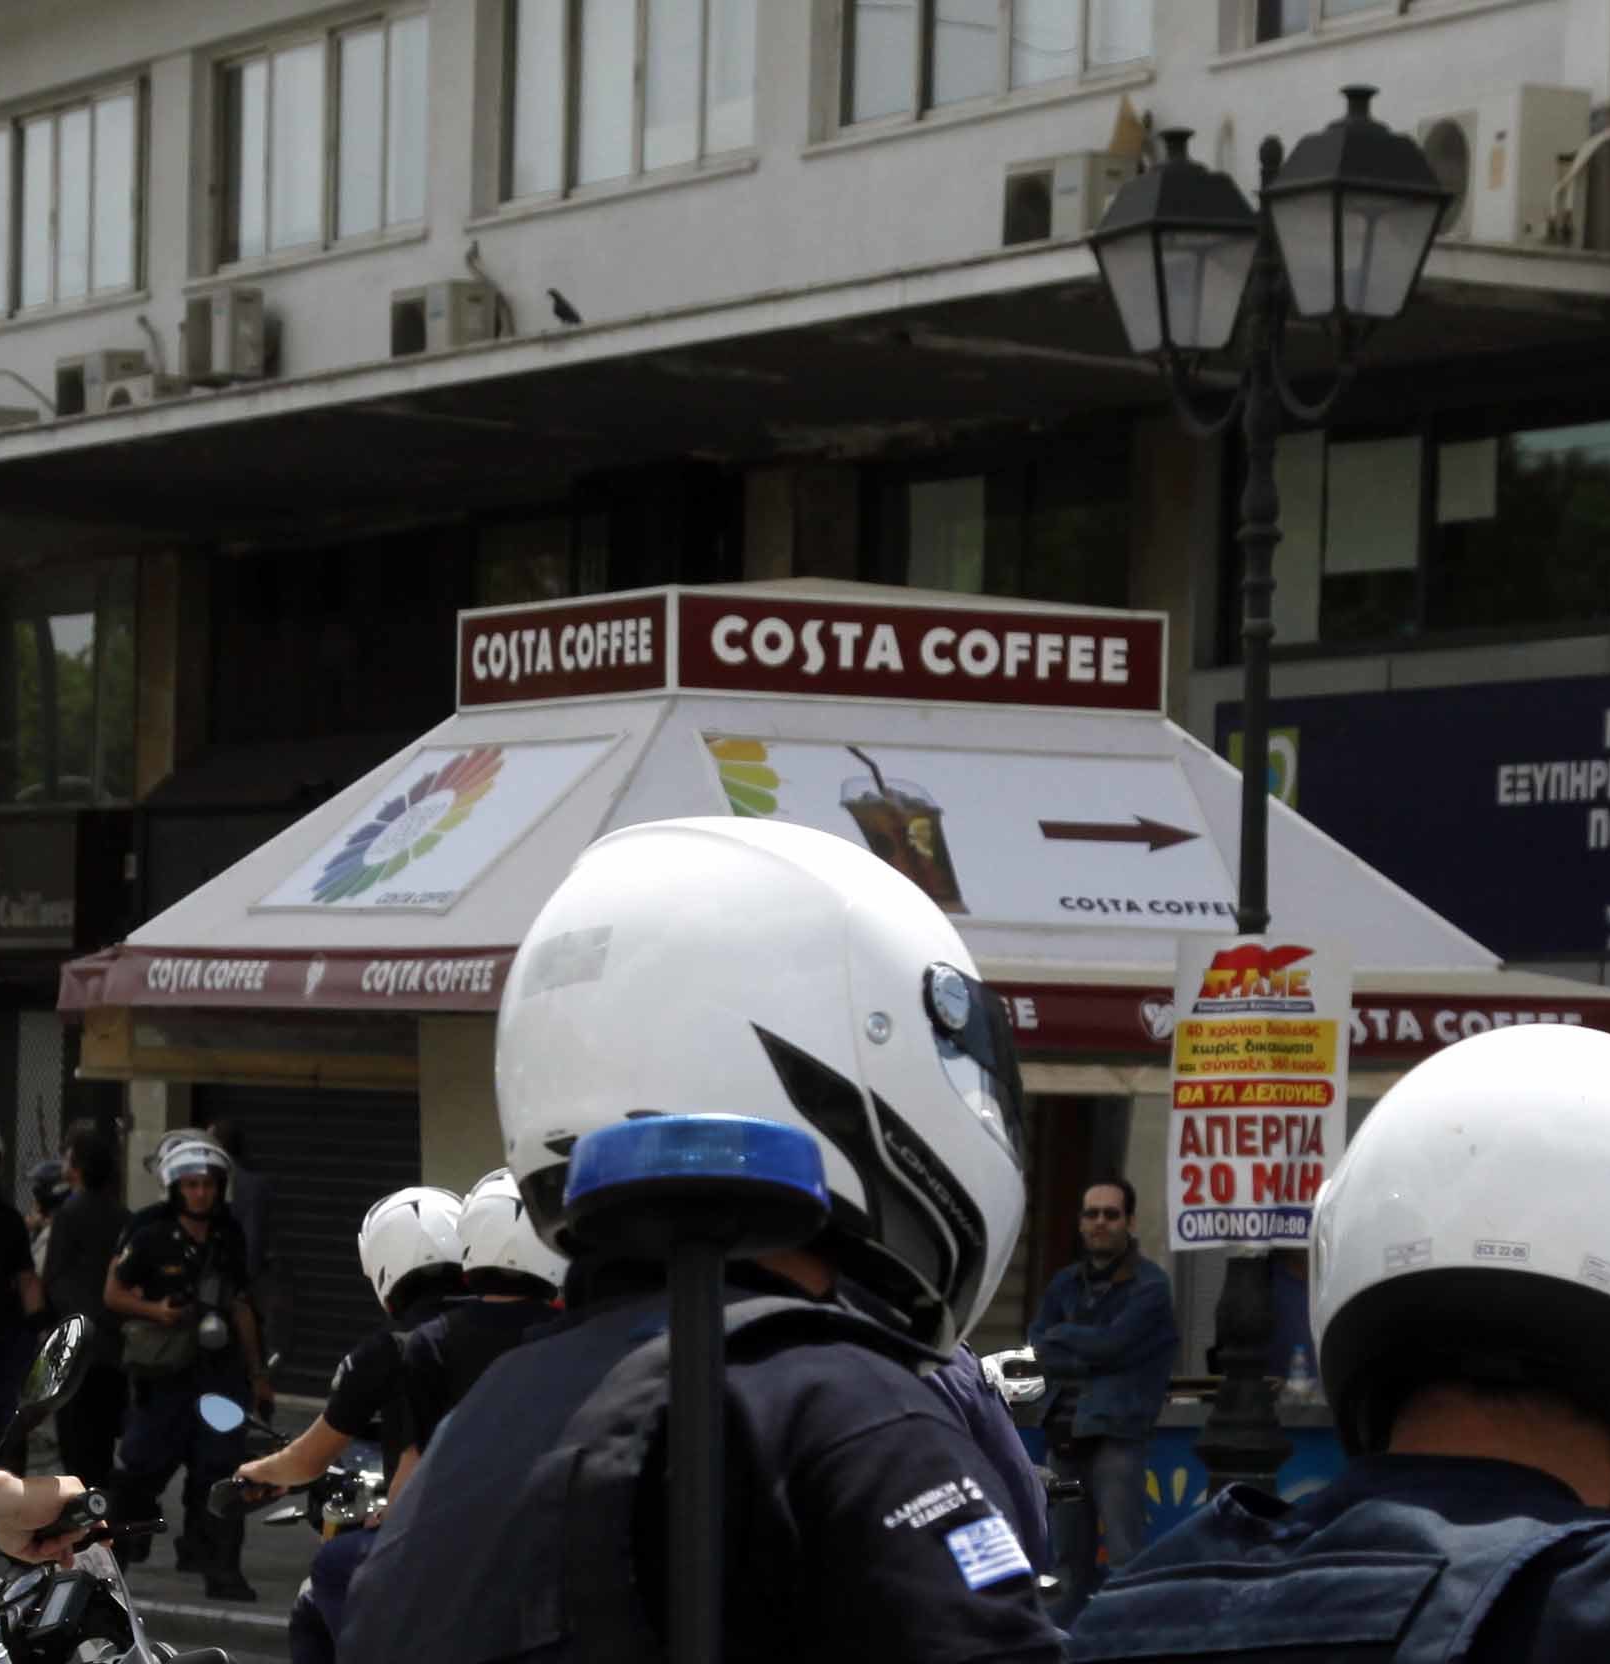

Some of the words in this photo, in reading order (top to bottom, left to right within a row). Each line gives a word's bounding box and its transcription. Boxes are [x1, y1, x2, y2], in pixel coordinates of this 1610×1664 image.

[472, 627, 553, 684] COSTA
[559, 617, 653, 671] COFFEE
[710, 614, 904, 675] COSTA
[920, 626, 1129, 684] COFFEE
[1059, 896, 1144, 915] COSTA
[1148, 900, 1235, 916] COFFE
[147, 958, 204, 993] COSTA
[203, 959, 269, 990] COFFEE
[360, 958, 420, 995] COSTA
[423, 958, 495, 993] COFFEE
[1349, 1008, 1424, 1045] STA
[1177, 1083, 1207, 1104] ΘΑ
[1211, 1083, 1237, 1104] ΤΑ
[1179, 1115, 1325, 1159] ΑΠΕΡΓΙΑ
[1180, 1162, 1235, 1206] 20
